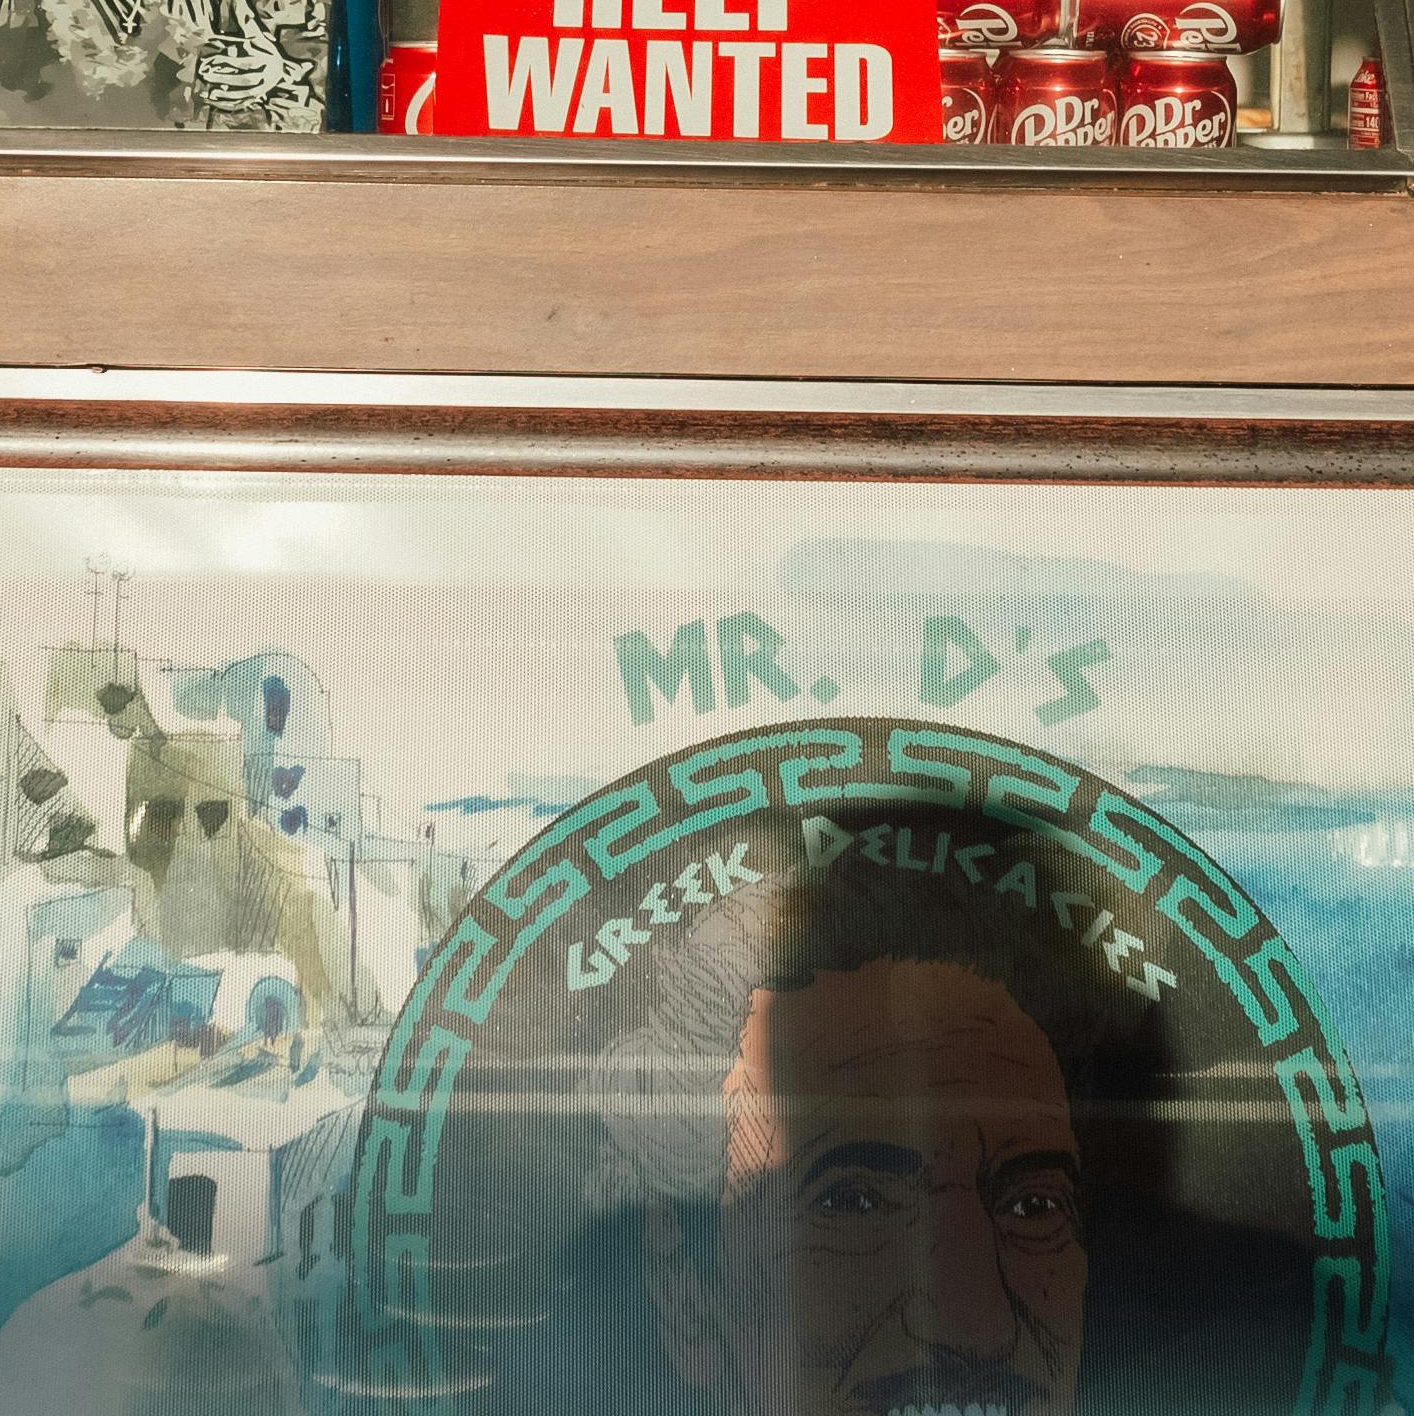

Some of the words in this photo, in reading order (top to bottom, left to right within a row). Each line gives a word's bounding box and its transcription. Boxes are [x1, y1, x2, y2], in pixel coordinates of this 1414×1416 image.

[482, 35, 894, 142] WANTED
[1055, 96, 1099, 134] Dr
[1155, 97, 1201, 135] Dr
[612, 609, 841, 725] MR.
[921, 612, 1114, 727] D'S
[564, 840, 765, 994] GREEK
[803, 814, 1179, 1005] DELICACIES
